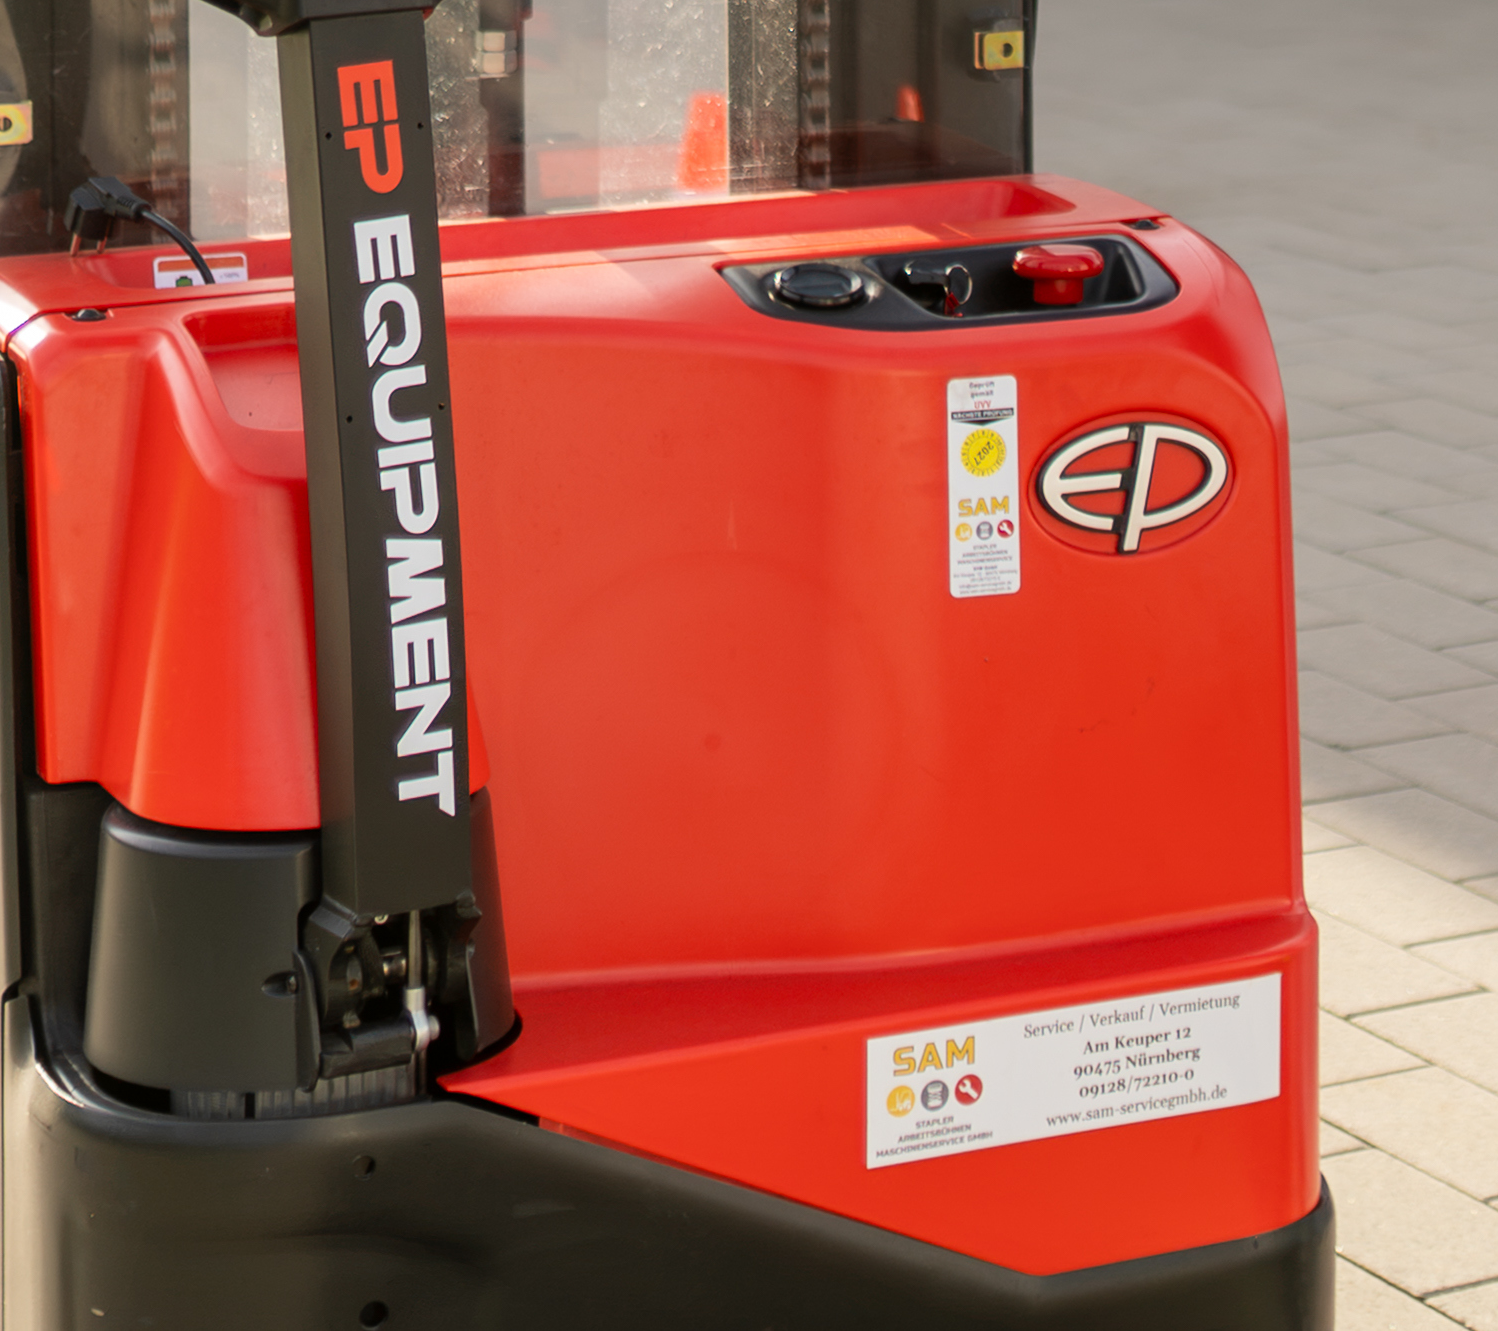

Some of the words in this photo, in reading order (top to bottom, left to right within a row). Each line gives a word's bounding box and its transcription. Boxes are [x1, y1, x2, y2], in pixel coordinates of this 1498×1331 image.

[337, 58, 405, 195] EP
[974, 400, 991, 409] UVV
[973, 441, 994, 467] 2027
[1039, 421, 1229, 554] EP
[352, 213, 457, 818] EQUIPMENT
[958, 495, 1010, 517] SAM
[1023, 1020, 1075, 1039] Service
[1079, 1014, 1085, 1034] /
[1089, 1005, 1146, 1028] Verkauf
[1159, 993, 1241, 1017] Vermietung
[893, 1035, 976, 1077] SAM
[1083, 1041, 1110, 1055] Am
[1114, 1030, 1172, 1050] Keuper
[1176, 1027, 1192, 1040] 12
[1073, 1059, 1121, 1081] 90475
[1124, 1047, 1201, 1070] Nürnberg
[1079, 1068, 1195, 1099] 09128/72210-0
[915, 1116, 954, 1130] STAPLER
[1045, 1084, 1229, 1128] www.sam-servicegmbh.de
